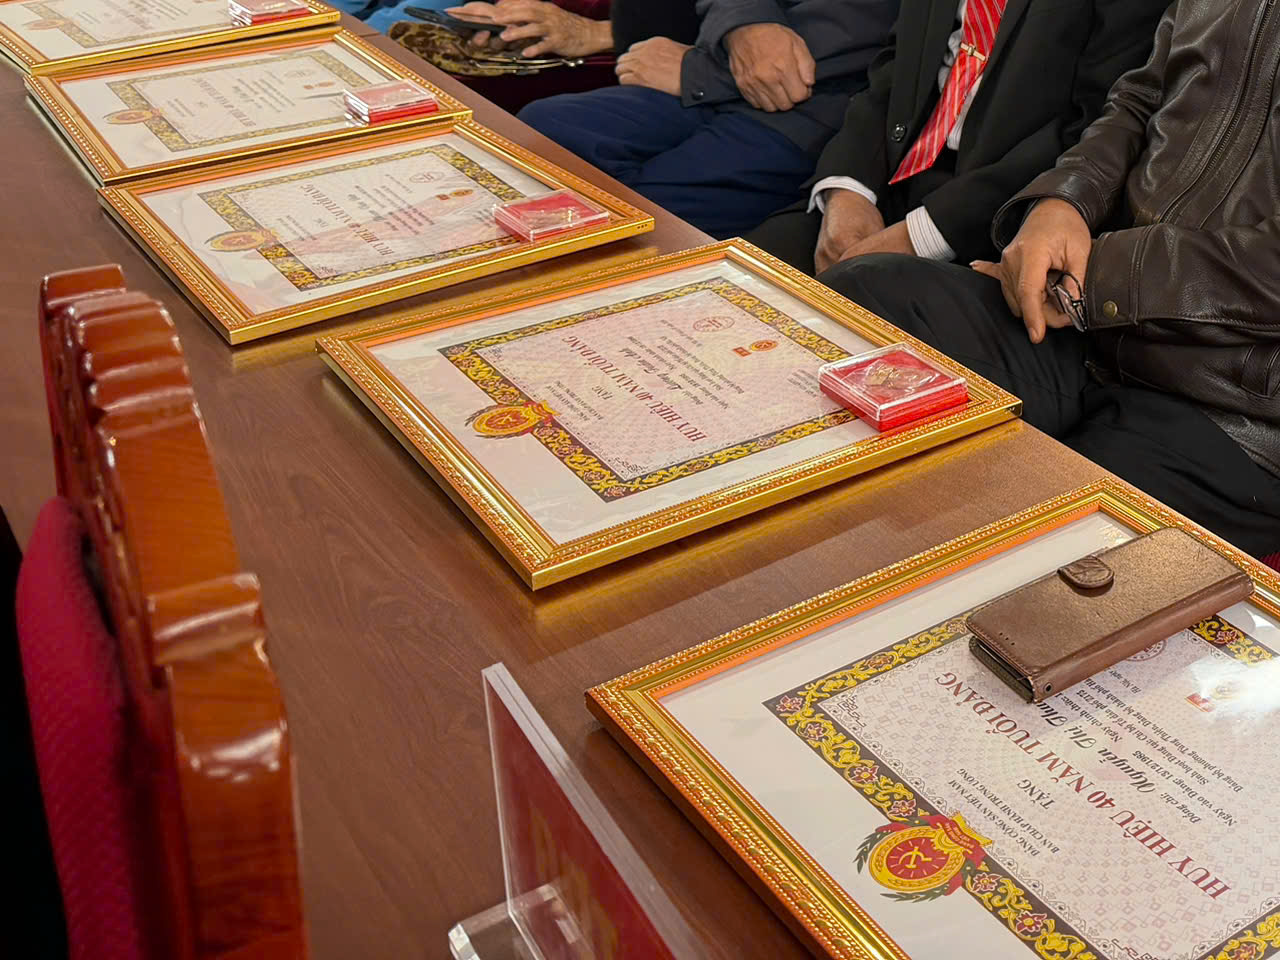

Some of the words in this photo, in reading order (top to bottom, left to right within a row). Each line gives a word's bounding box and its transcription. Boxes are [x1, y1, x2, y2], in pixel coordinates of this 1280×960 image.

[561, 335, 597, 357] ĐẢNG
[583, 354, 620, 375] TUỔI
[610, 372, 644, 393] NĂM
[645, 401, 682, 423] HIỆU
[672, 421, 707, 442] HUY
[934, 672, 996, 716] ĐẢNG
[1105, 692, 1126, 708] thành
[1079, 709, 1103, 727] chính
[1132, 711, 1152, 727] Đảng
[985, 711, 1042, 755] TUỔI
[1063, 725, 1097, 749] Thị
[1100, 726, 1123, 743] Ngày
[1156, 745, 1177, 763] Đảng
[1169, 738, 1189, 755] Tùng
[1131, 750, 1174, 780] 13/12/1985
[1173, 759, 1193, 774] hoạt
[1186, 750, 1217, 771] phường
[956, 768, 980, 787] ƯƠNG
[1035, 750, 1095, 794] NĂM
[1097, 748, 1156, 793] Nguyễn
[1190, 770, 1209, 785] Sinh
[947, 779, 968, 795] NAM
[1172, 777, 1198, 799] Đảng:
[1221, 775, 1244, 793] Đảng
[963, 793, 983, 809] VIỆT
[975, 784, 1003, 807] TRUNG
[1016, 779, 1055, 810] TẶNG
[1086, 790, 1116, 808] 40
[1159, 792, 1179, 805] chí:
[1196, 796, 1213, 809] vào
[980, 807, 999, 821] SẢN
[999, 804, 1024, 824] HÀNH
[1175, 803, 1202, 824] Đồng
[1212, 808, 1237, 827] Ngày
[994, 819, 1019, 838] CỘNG
[1019, 823, 1044, 840] CHẤP
[1108, 810, 1177, 858] HIỆU
[1015, 836, 1040, 857] ĐẢNG
[1039, 838, 1060, 854] BAN
[1167, 855, 1231, 900] HUY
